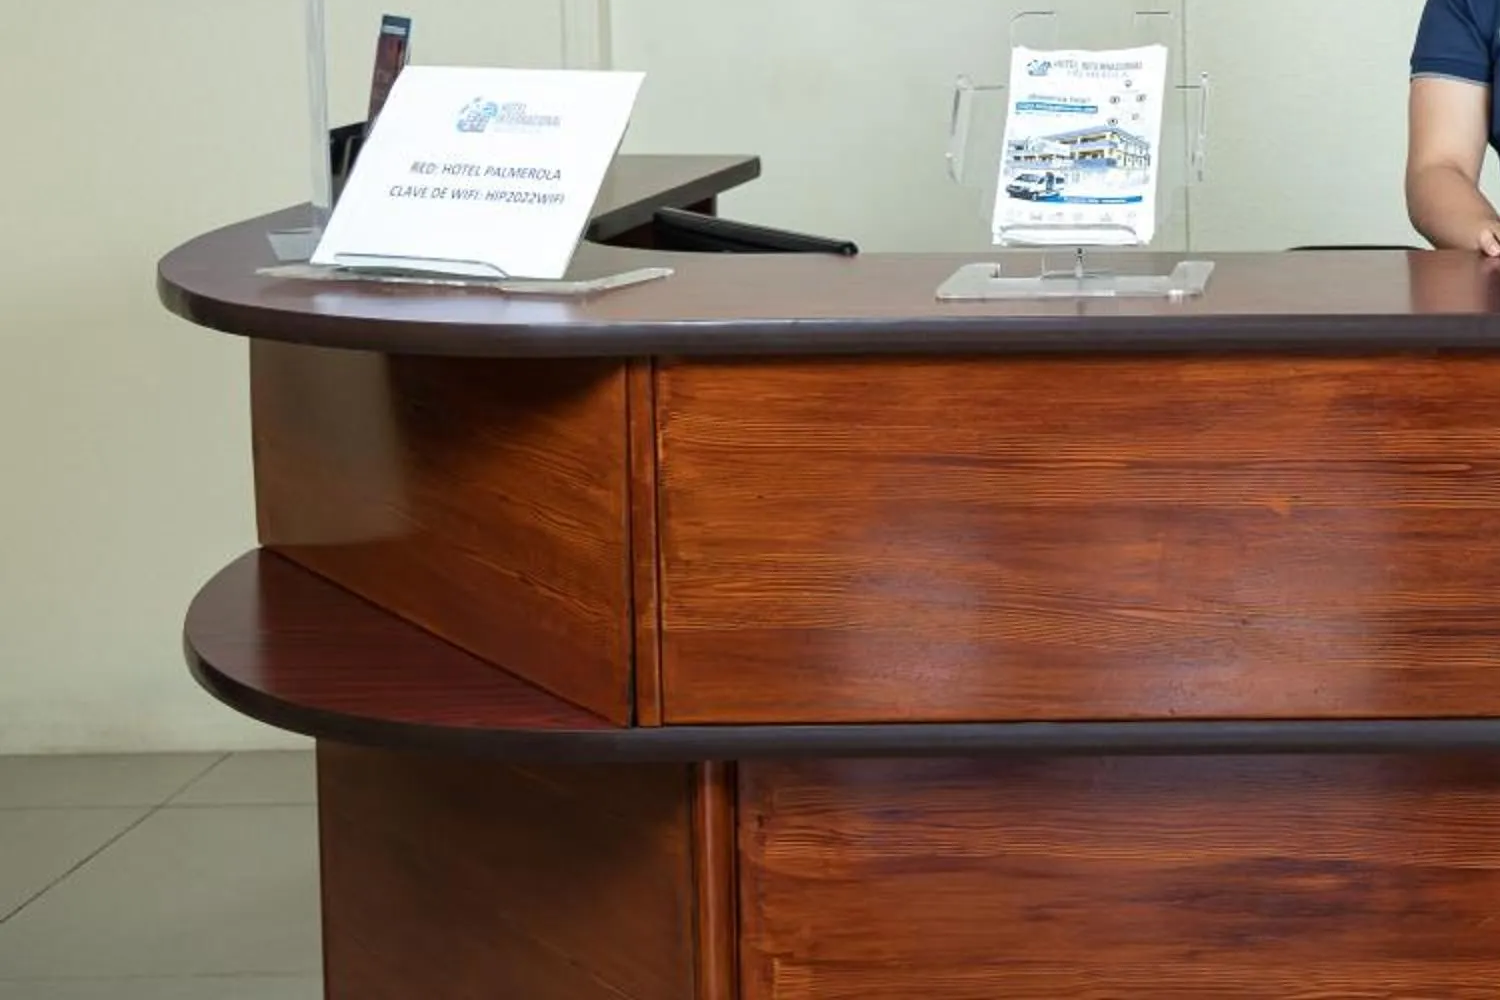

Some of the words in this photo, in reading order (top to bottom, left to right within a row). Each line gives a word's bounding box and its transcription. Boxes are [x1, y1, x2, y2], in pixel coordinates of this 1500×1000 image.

[410, 160, 438, 175] RED:
[441, 162, 482, 178] HOTEL
[483, 165, 562, 182] PALMEROLA
[389, 184, 428, 199] CLAVE
[430, 186, 449, 200] DE
[450, 188, 483, 202] WIFI:
